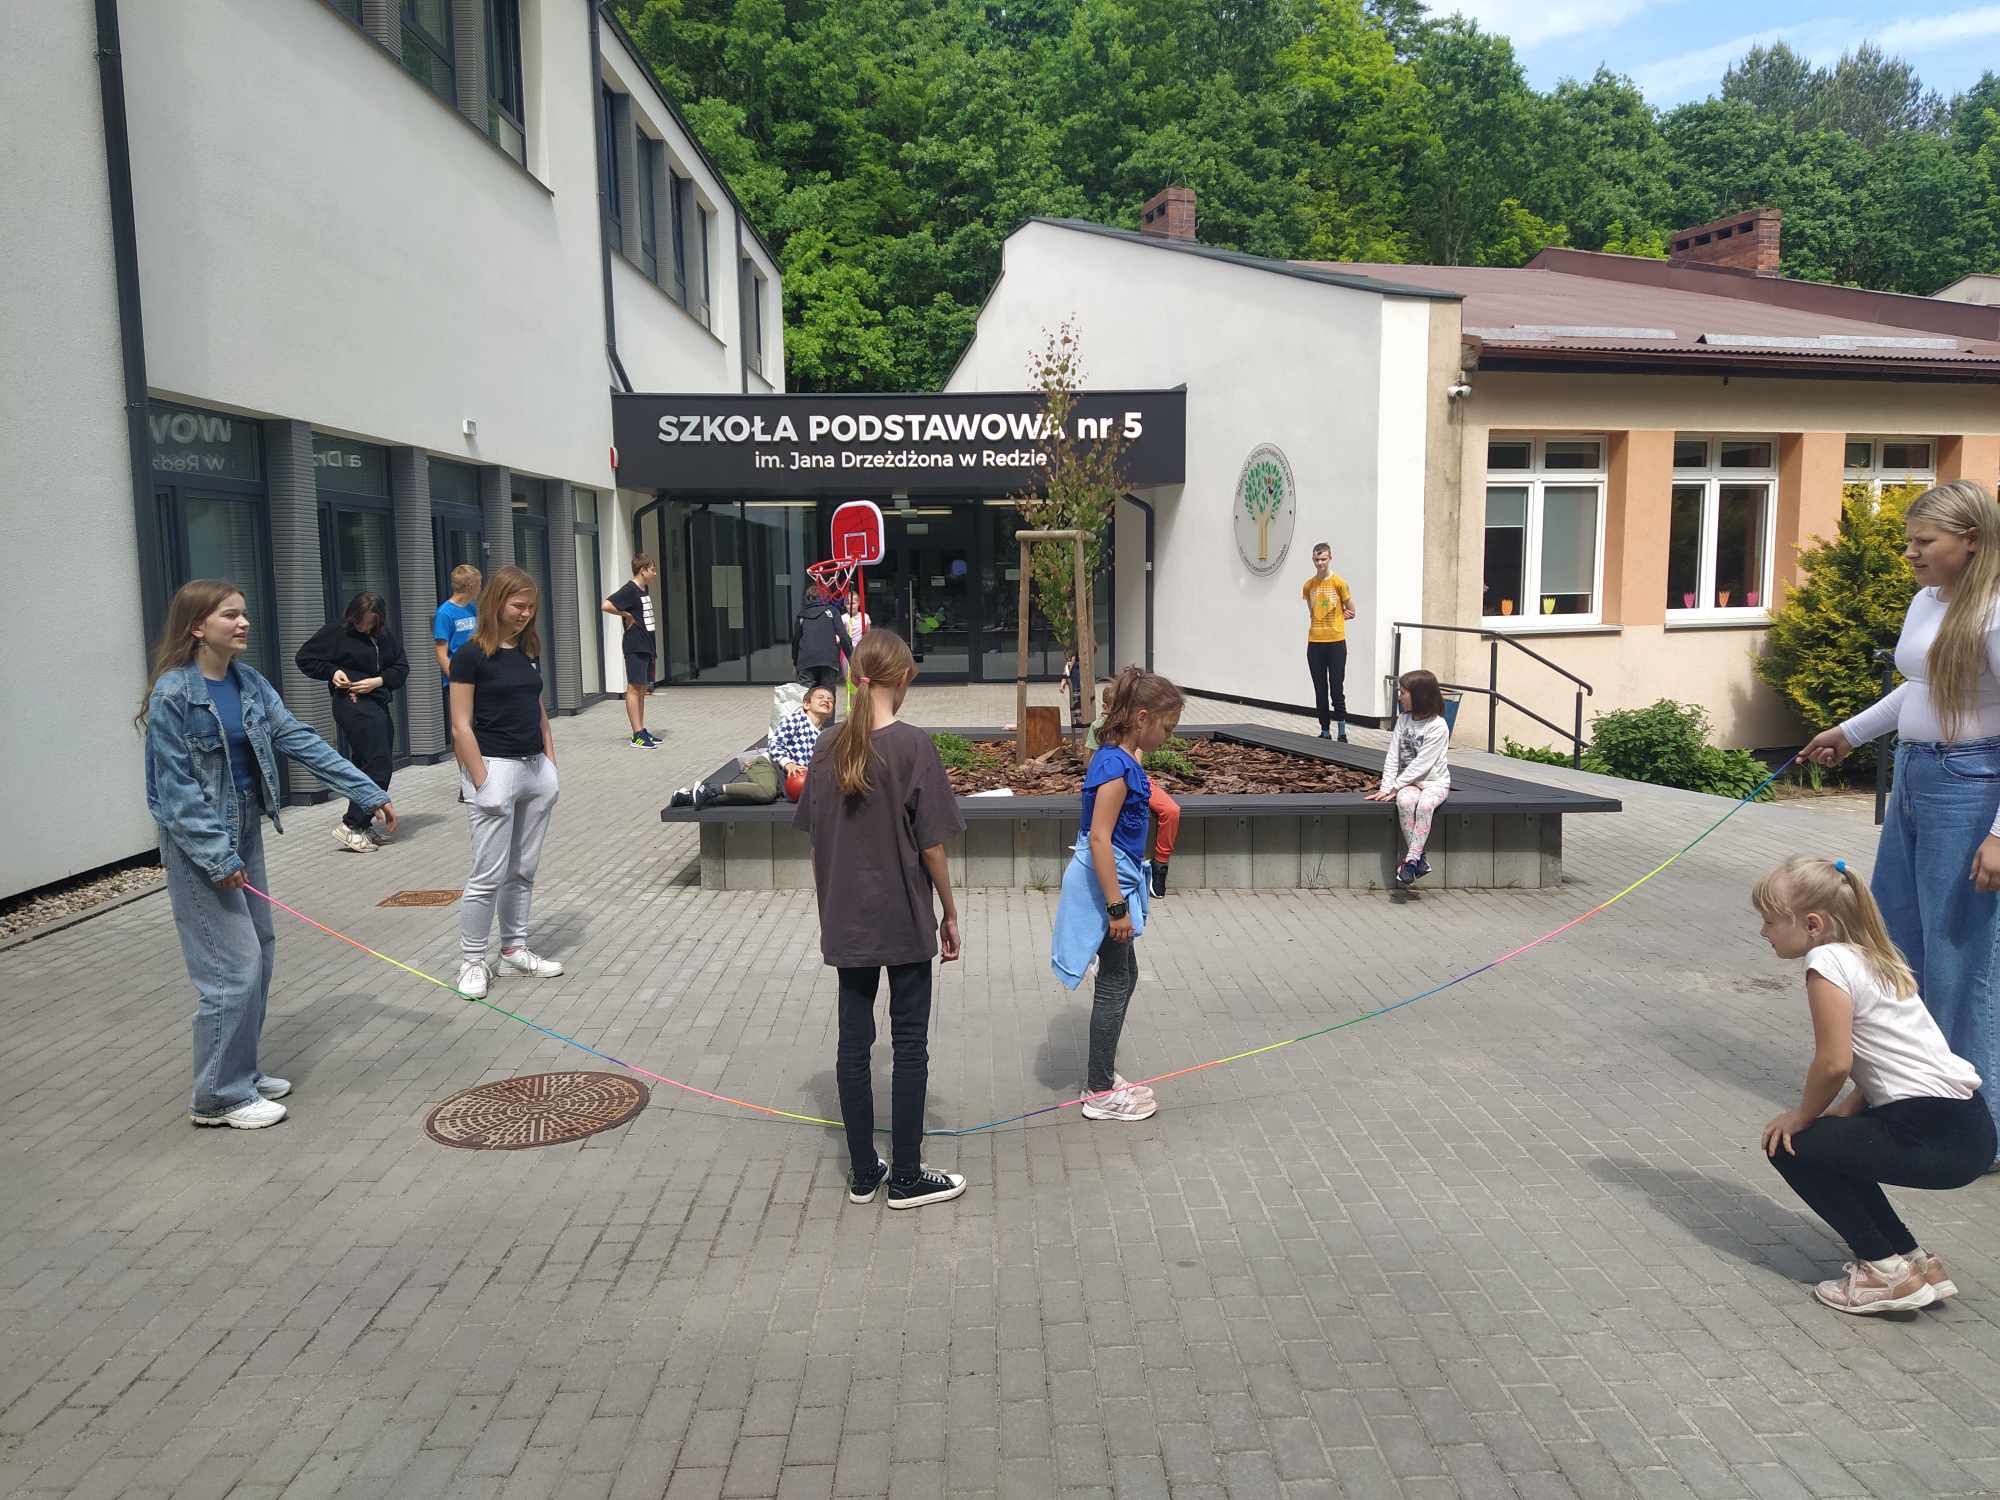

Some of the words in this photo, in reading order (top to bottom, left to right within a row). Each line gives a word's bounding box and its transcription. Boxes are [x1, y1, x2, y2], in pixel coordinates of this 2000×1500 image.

[658, 415, 798, 442] SZKOŁA
[809, 413, 1065, 442] PODSTAWOWA
[1077, 417, 1112, 440] nr
[1122, 411, 1143, 439] 5
[755, 450, 785, 469] im.
[789, 451, 835, 470] Jana
[841, 449, 954, 469] Drzeżdżona
[958, 453, 977, 467] w
[982, 448, 1048, 467] Redzie
